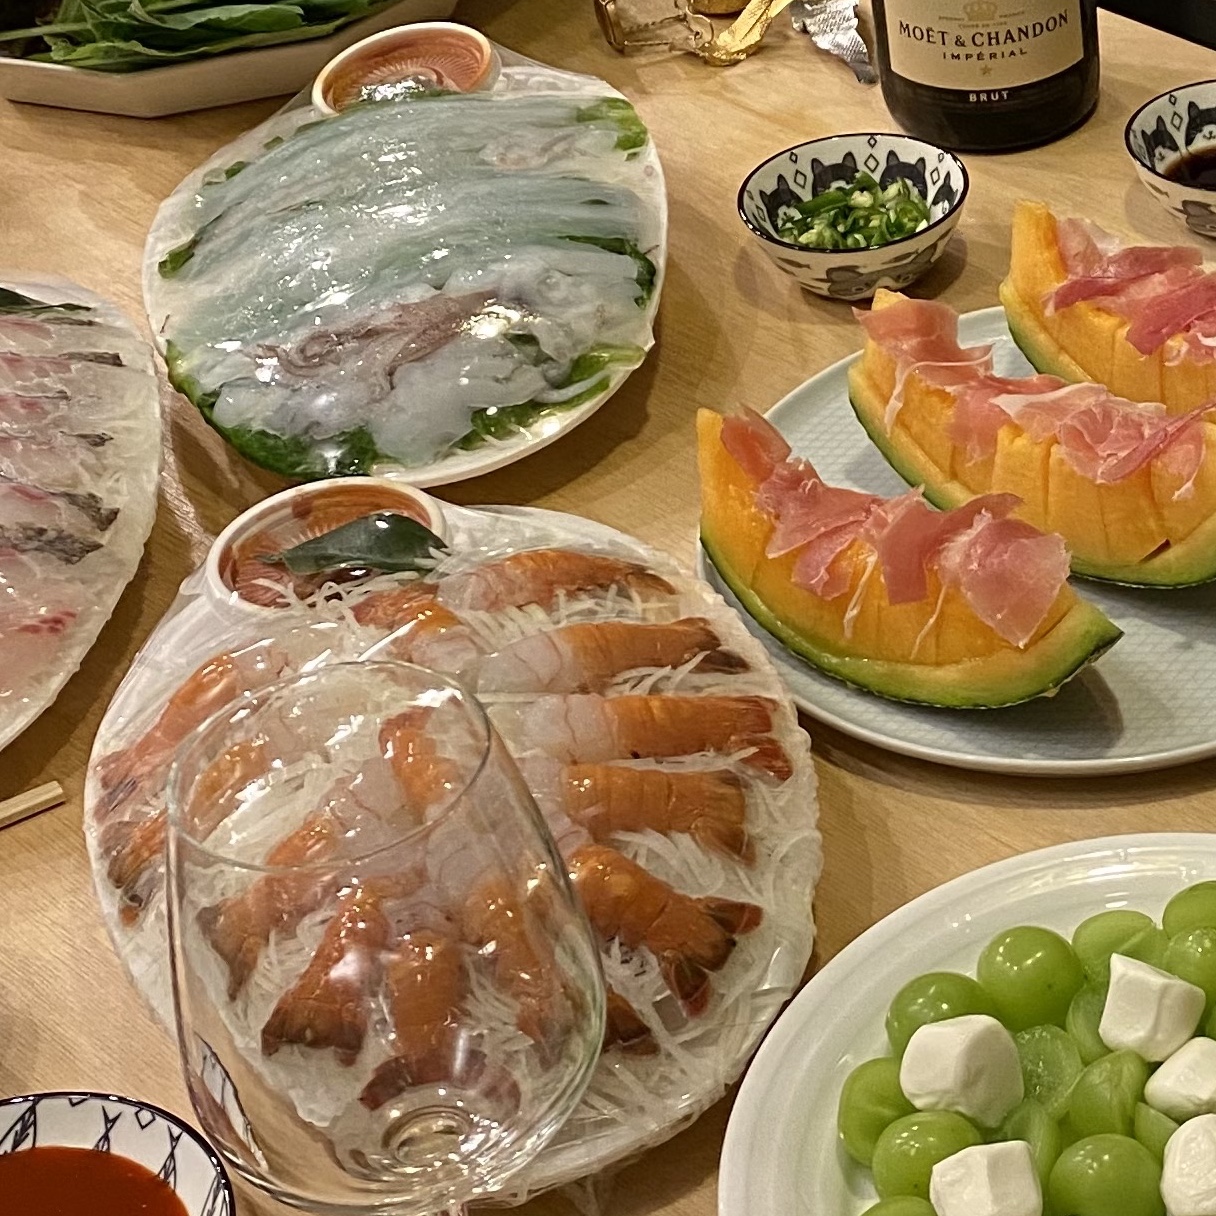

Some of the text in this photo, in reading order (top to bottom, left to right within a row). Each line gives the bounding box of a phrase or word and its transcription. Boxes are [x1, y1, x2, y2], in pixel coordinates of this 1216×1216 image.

[899, 9, 1068, 48] MOËT & CHANDON
[943, 48, 1028, 61] IMPÉRIAL
[969, 91, 1010, 102] BRUT
